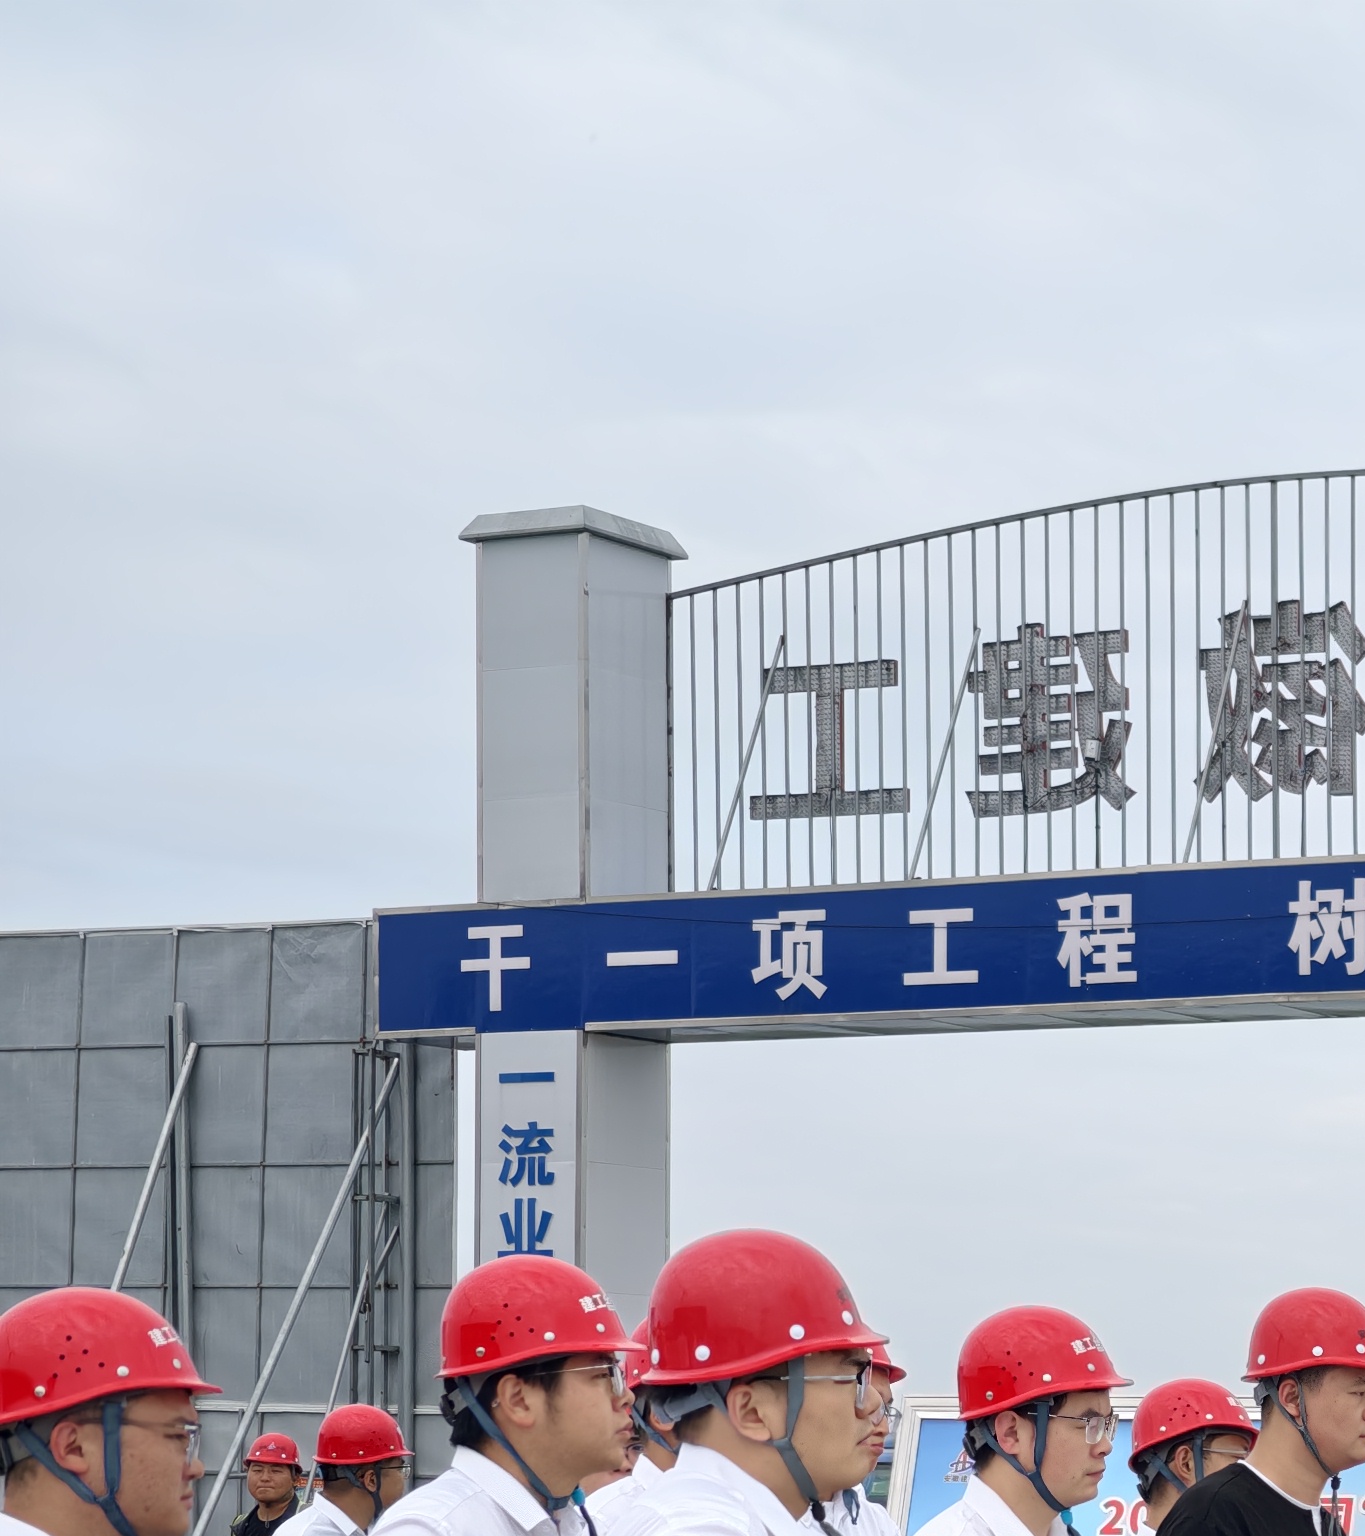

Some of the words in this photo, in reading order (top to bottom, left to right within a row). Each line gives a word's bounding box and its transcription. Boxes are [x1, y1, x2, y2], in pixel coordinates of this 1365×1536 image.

[460, 892, 1137, 1011] 干一项工程
